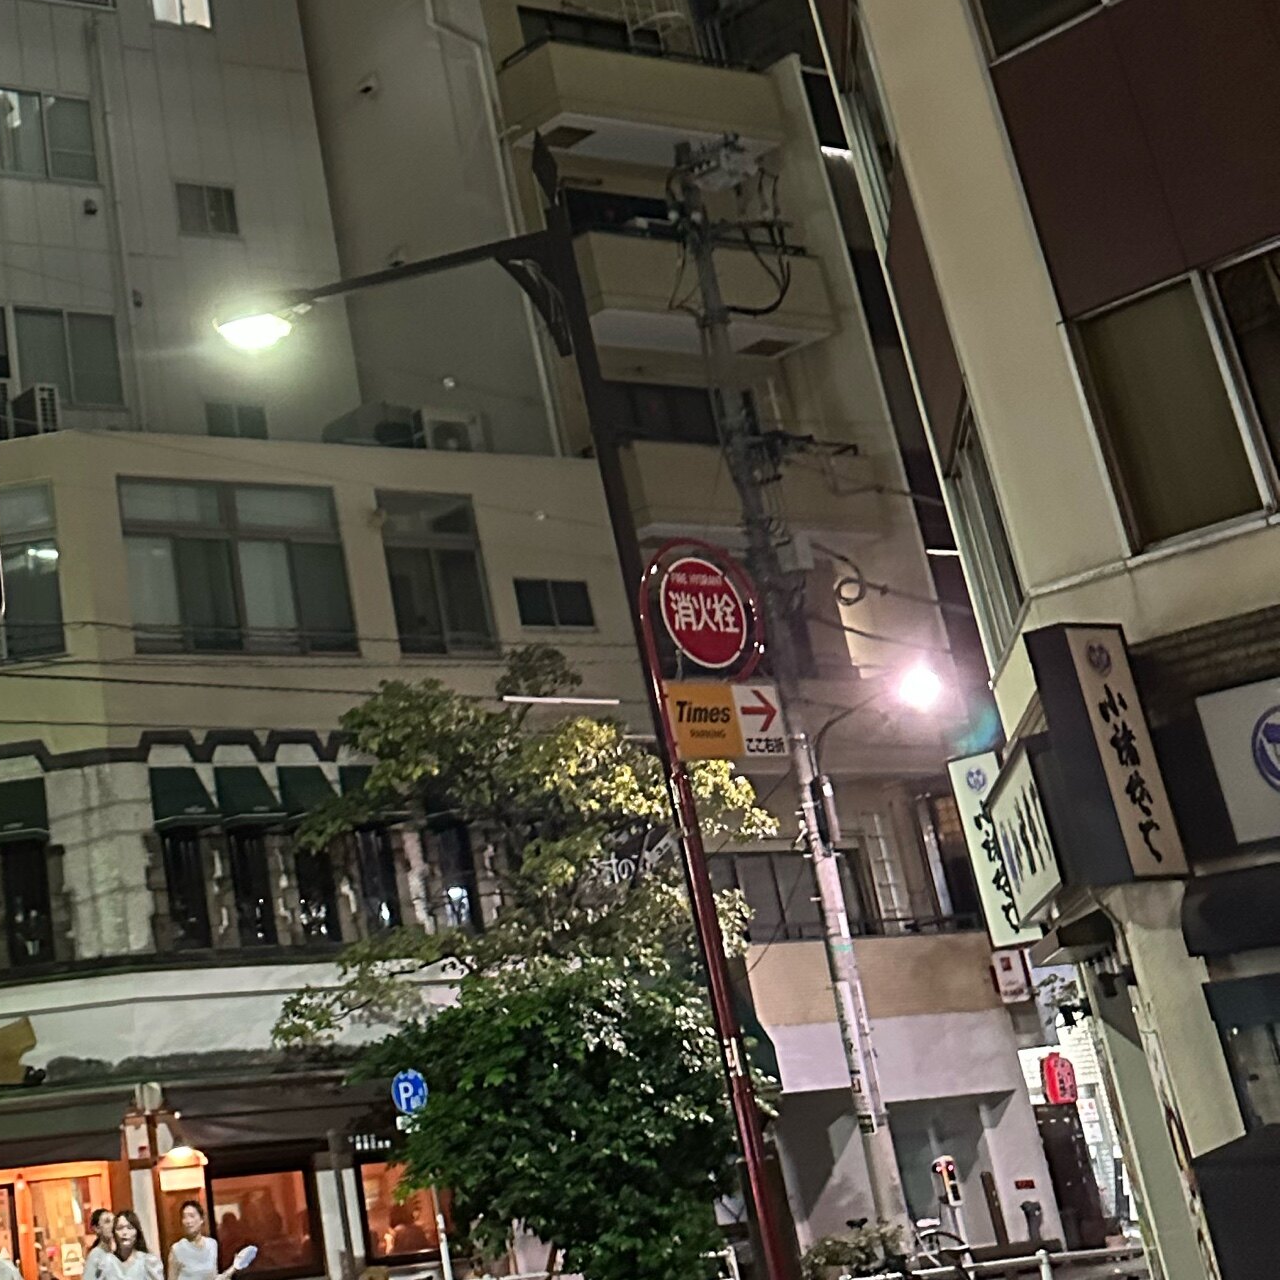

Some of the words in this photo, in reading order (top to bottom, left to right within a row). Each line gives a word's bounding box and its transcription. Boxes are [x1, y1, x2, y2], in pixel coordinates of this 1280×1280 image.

[668, 591, 740, 633] 消火栓
[676, 701, 730, 723] Times
[399, 1081, 414, 1110] P
